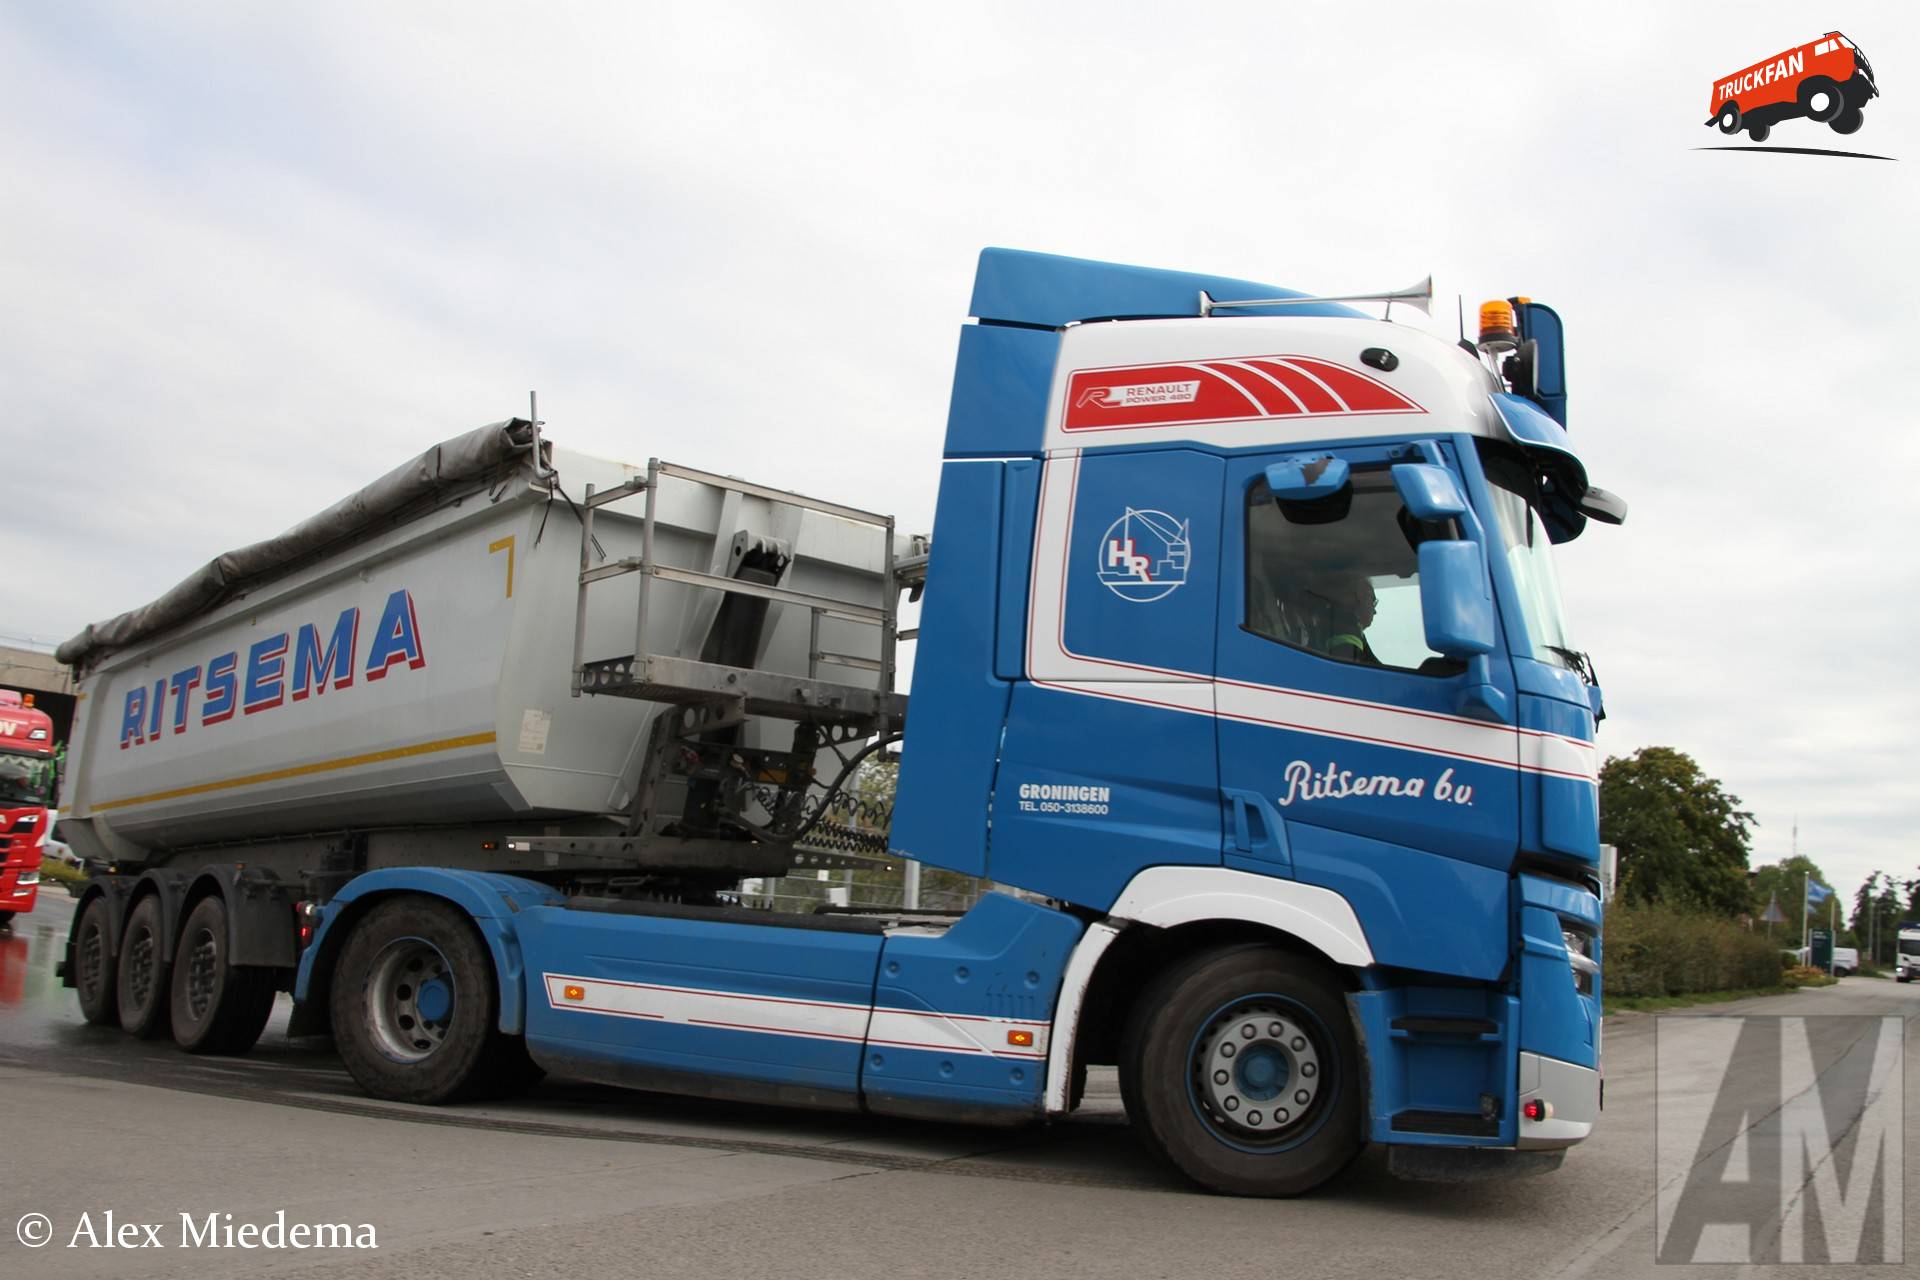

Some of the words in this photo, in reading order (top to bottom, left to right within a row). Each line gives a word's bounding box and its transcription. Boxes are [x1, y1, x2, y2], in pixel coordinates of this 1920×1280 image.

[1126, 383, 1192, 397] RENAULT
[1126, 395, 1166, 404] POWER
[1169, 393, 1192, 401] 480
[120, 588, 426, 750] RITSEMA
[1278, 760, 1425, 807] Ritsema
[1433, 767, 1473, 806] b.v.
[1019, 783, 1110, 803] GRONINGEN
[1040, 801, 1109, 815] 050-3138600
